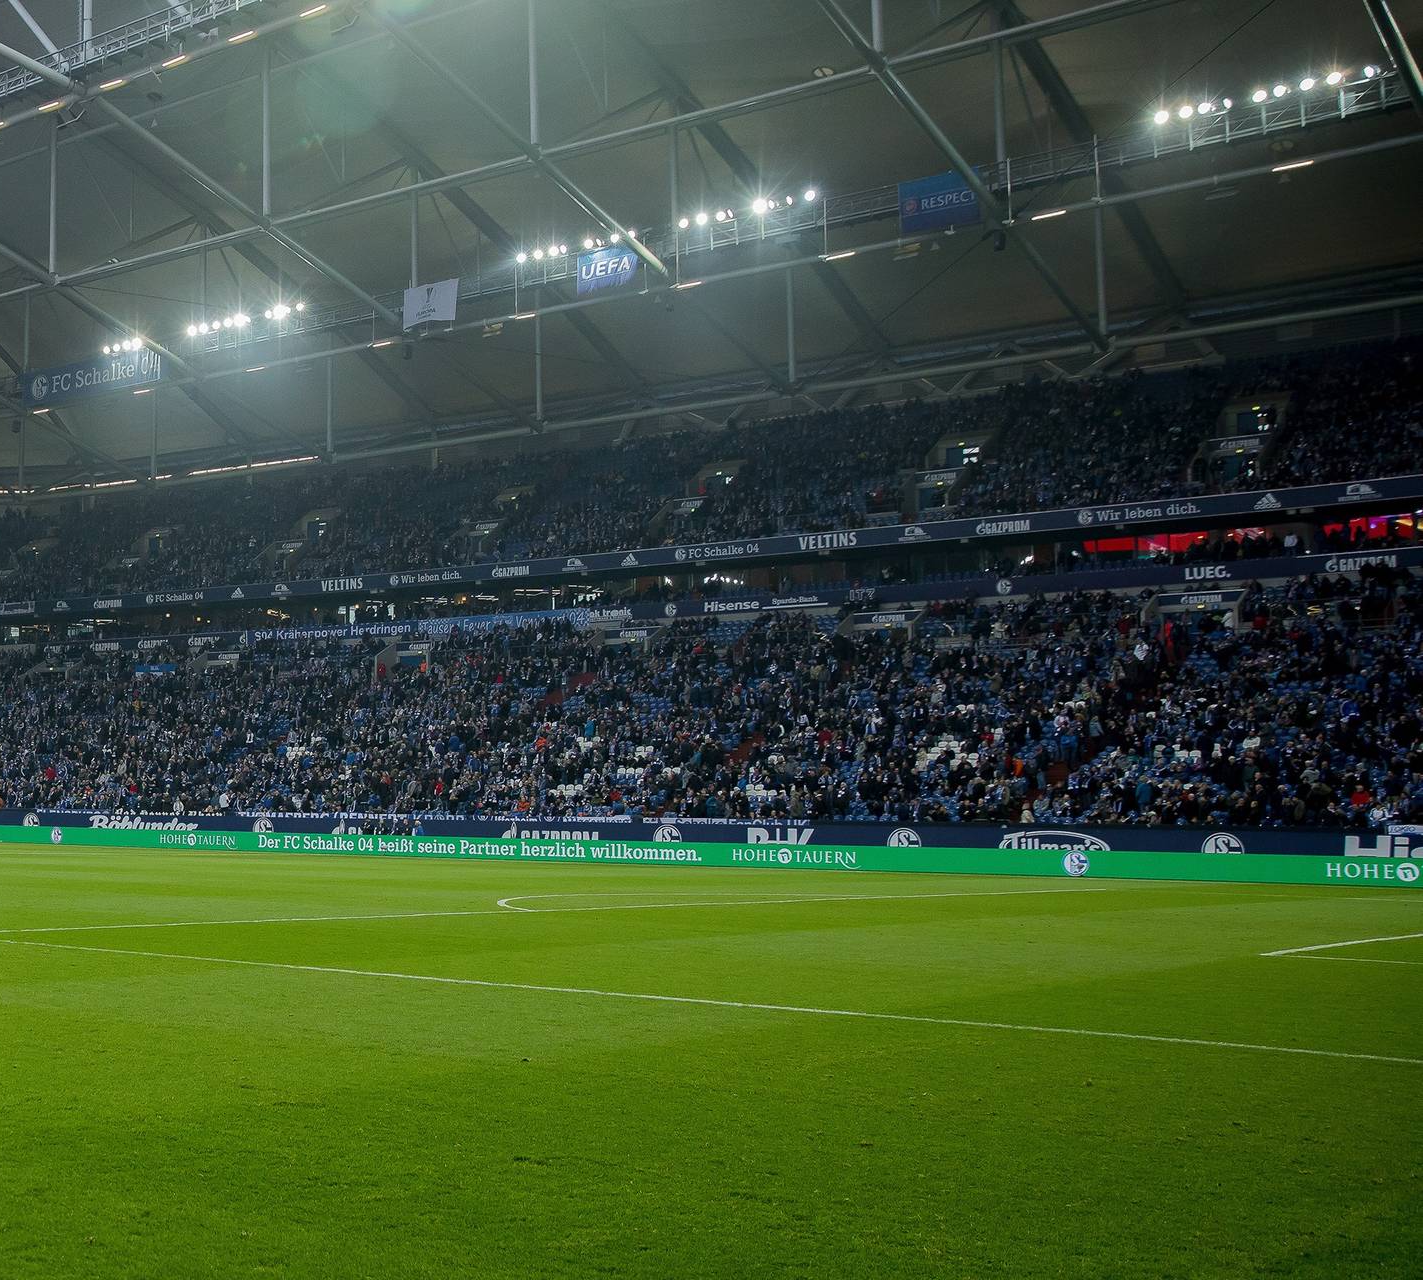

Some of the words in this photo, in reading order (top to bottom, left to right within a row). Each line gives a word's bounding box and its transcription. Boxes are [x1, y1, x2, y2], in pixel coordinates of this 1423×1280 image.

[921, 190, 977, 210] RESPECT
[580, 257, 632, 281] UEFA
[52, 374, 71, 393] FC
[75, 362, 135, 389] Schalke
[1096, 509, 1121, 521] Wir
[1124, 505, 1162, 520] leben
[1165, 502, 1201, 516] dich.
[985, 520, 1030, 534] GAZPROM
[798, 532, 857, 550] VELTINS
[688, 549, 702, 559] FC
[704, 546, 744, 558] Schalke
[746, 543, 760, 555] 04
[401, 573, 416, 584] Wir
[417, 571, 440, 584] leben
[441, 570, 462, 581] dich.
[497, 565, 530, 578] GAZPROM
[1185, 565, 1231, 580] LUEG.
[321, 577, 363, 592] VELTINS
[155, 594, 165, 604] FC
[166, 592, 194, 603] Schalke
[704, 599, 760, 613] Hisense
[350, 622, 411, 637] Herdringen
[160, 834, 187, 844] HOHE
[197, 835, 238, 849] TAUERN
[258, 835, 279, 848] Der
[283, 836, 300, 849] FC
[303, 836, 354, 851] Schalke
[358, 838, 373, 851] 04
[378, 837, 414, 853] heißt
[417, 841, 455, 854] seine
[459, 839, 517, 856] Partner
[521, 841, 586, 858] herzlich
[590, 842, 702, 862] willkommen.
[732, 849, 777, 863] HOHE
[795, 850, 862, 869] TAUERN
[1325, 862, 1396, 879] HOHE
